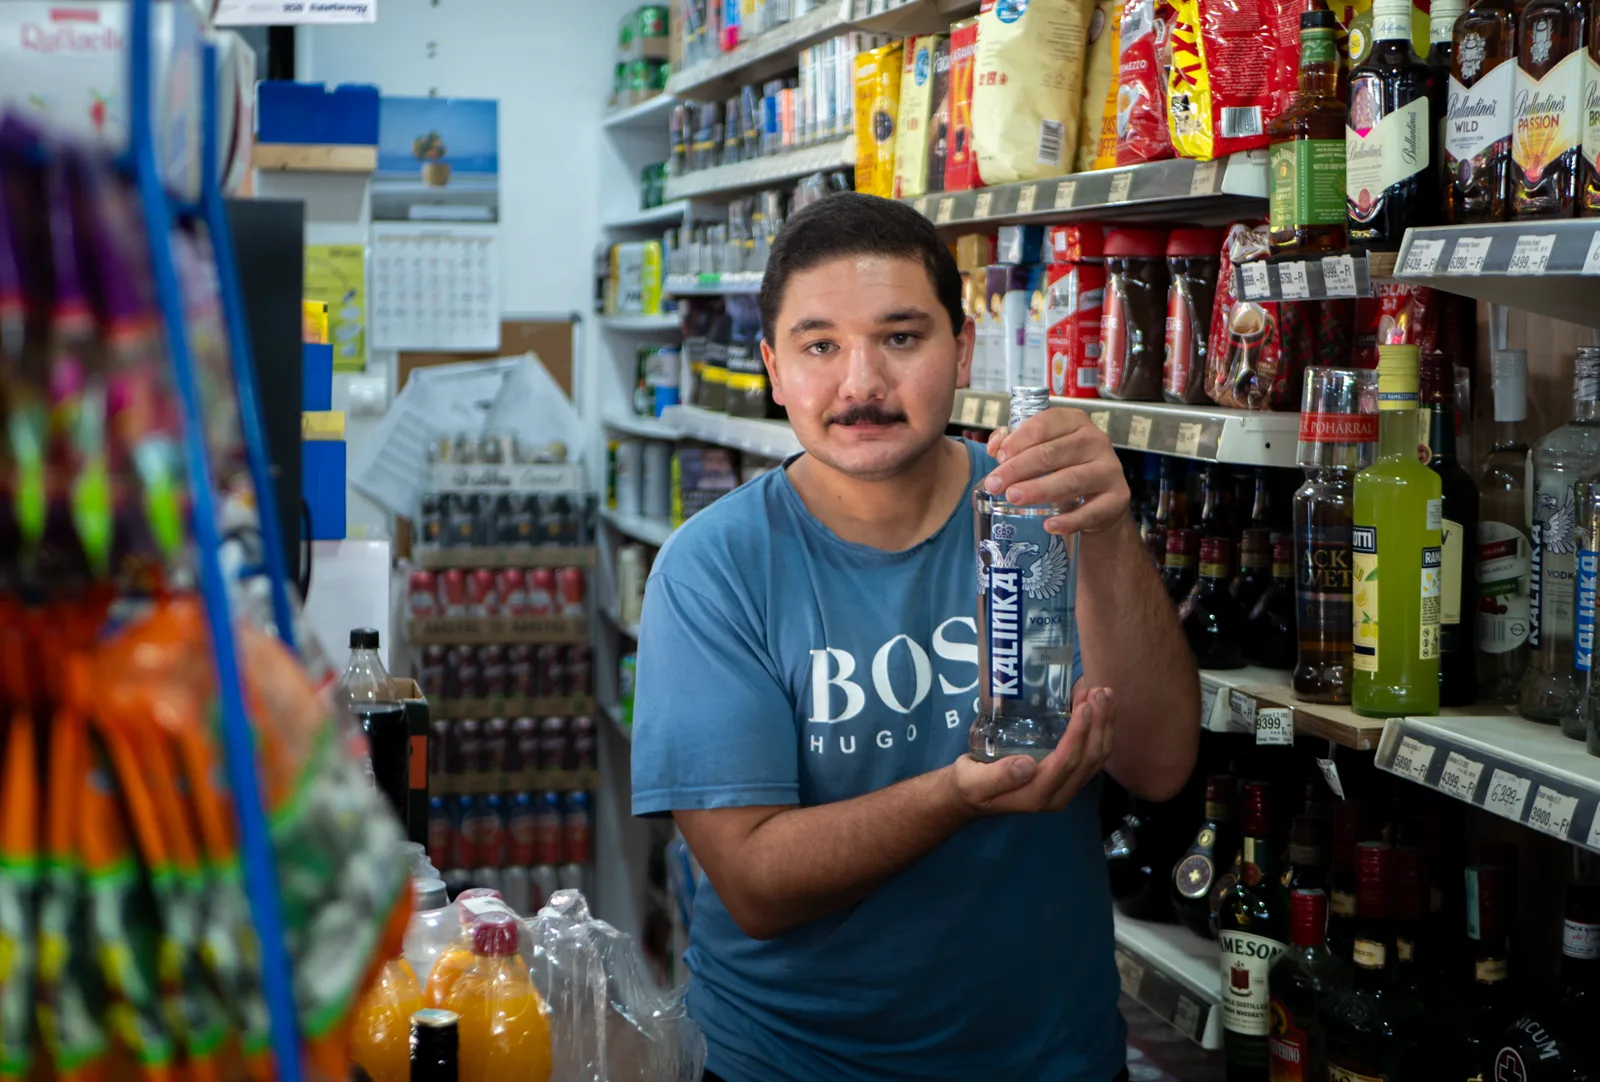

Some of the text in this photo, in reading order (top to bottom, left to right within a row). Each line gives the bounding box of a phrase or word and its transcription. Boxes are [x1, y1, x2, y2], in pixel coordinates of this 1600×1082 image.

[1447, 92, 1498, 121] Ballantine's
[1514, 88, 1567, 120] Ballantine's
[1454, 120, 1479, 134] WILD
[1517, 113, 1560, 133] PASSION
[1029, 616, 1062, 625] VODKA
[810, 724, 917, 754] HUGO
